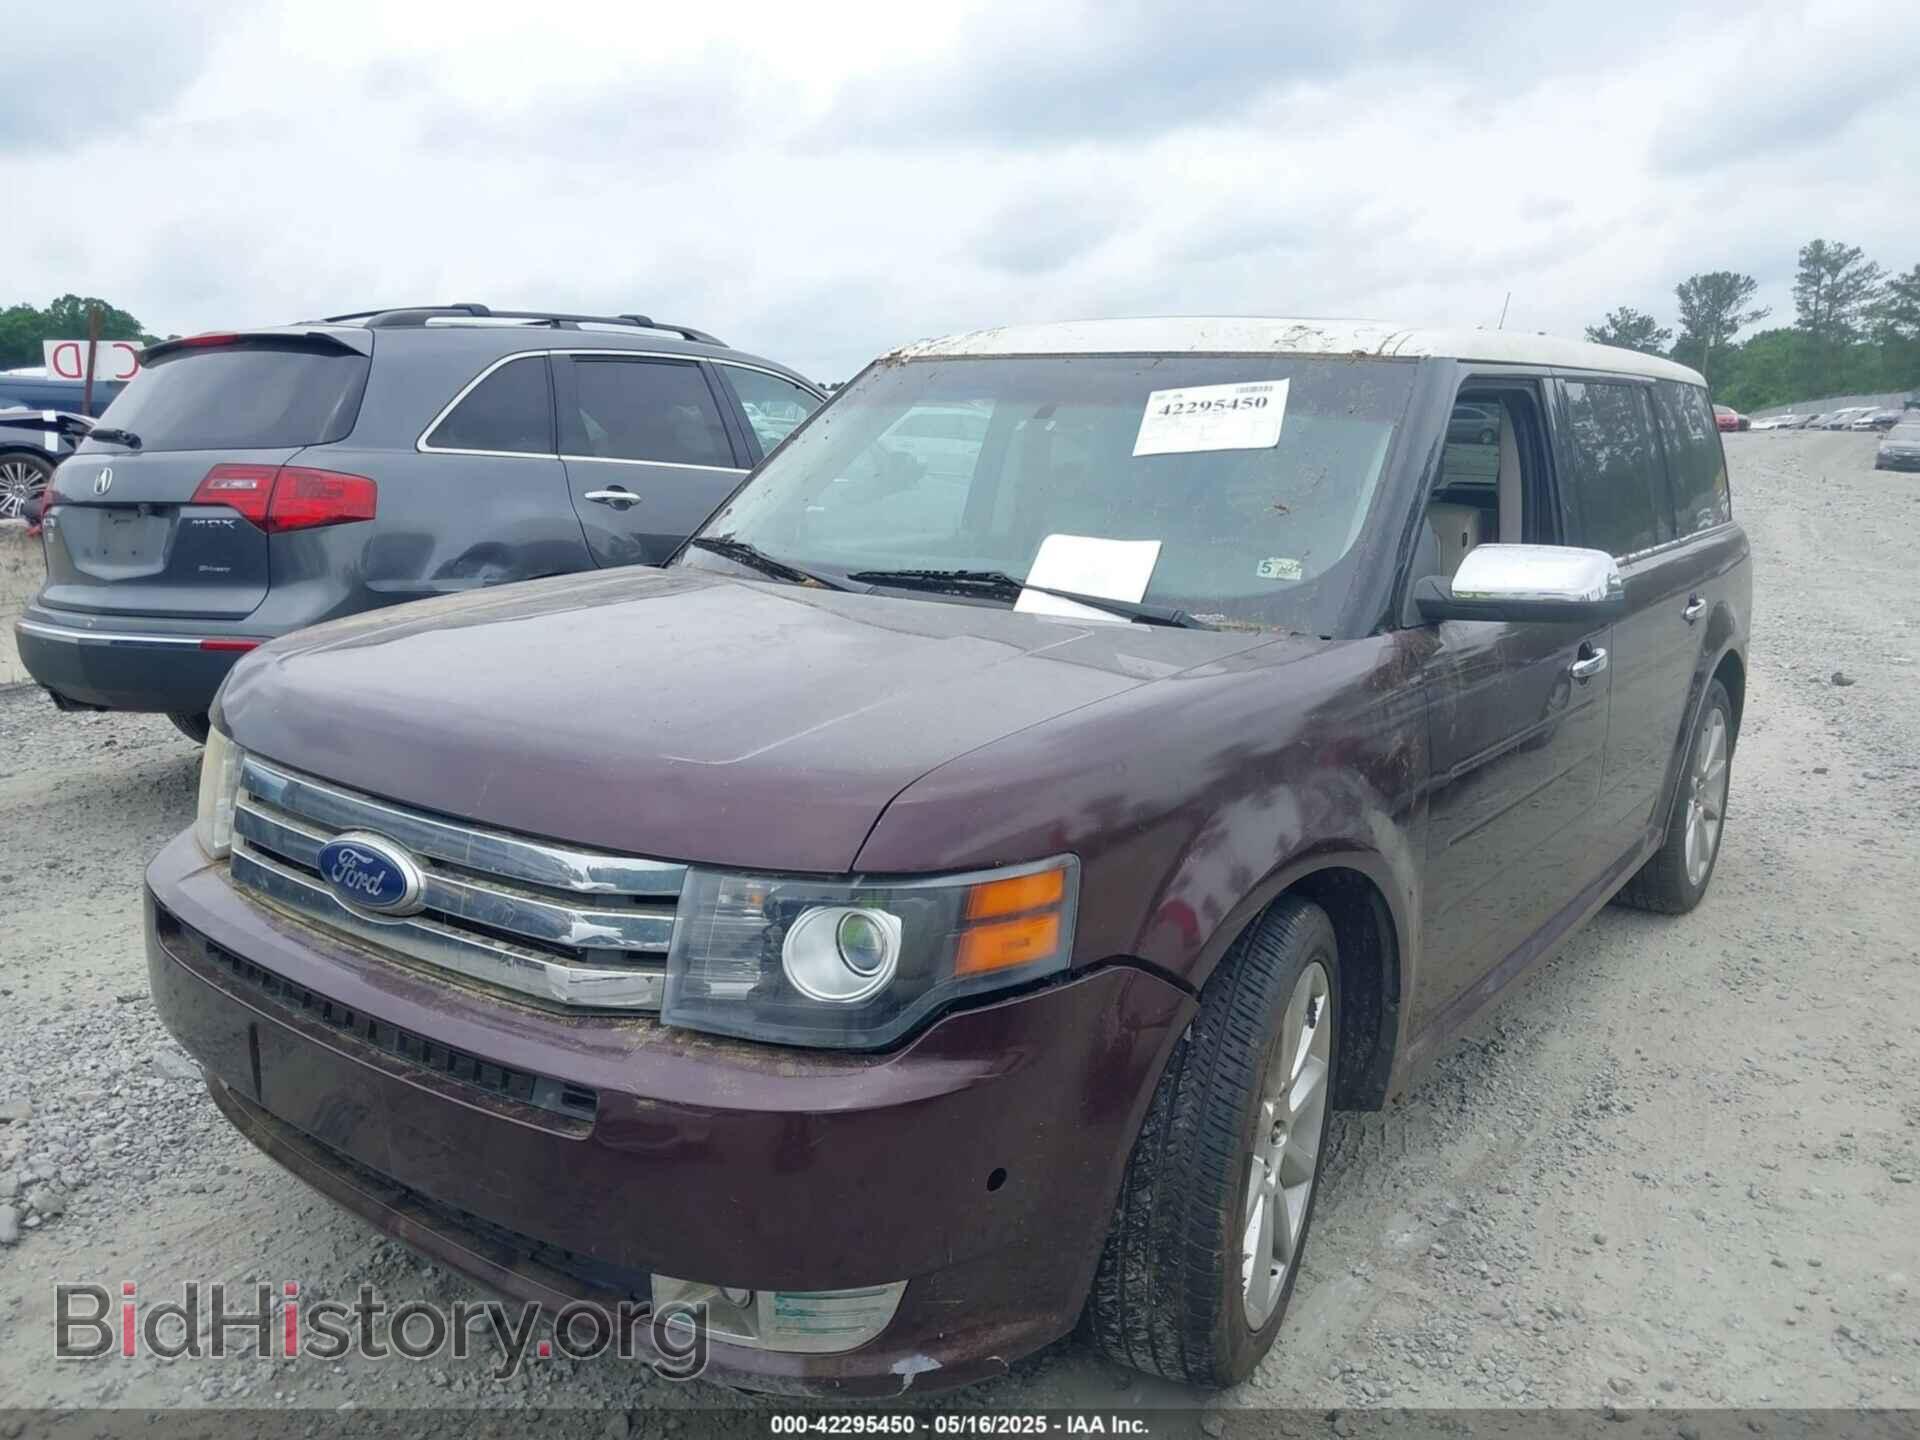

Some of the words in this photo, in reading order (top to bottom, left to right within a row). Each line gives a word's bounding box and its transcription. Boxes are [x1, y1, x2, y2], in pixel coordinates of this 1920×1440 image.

[1158, 396, 1268, 416] 42295450
[191, 519, 235, 529] MDX
[1262, 561, 1273, 574] 5
[331, 847, 387, 896] Ford
